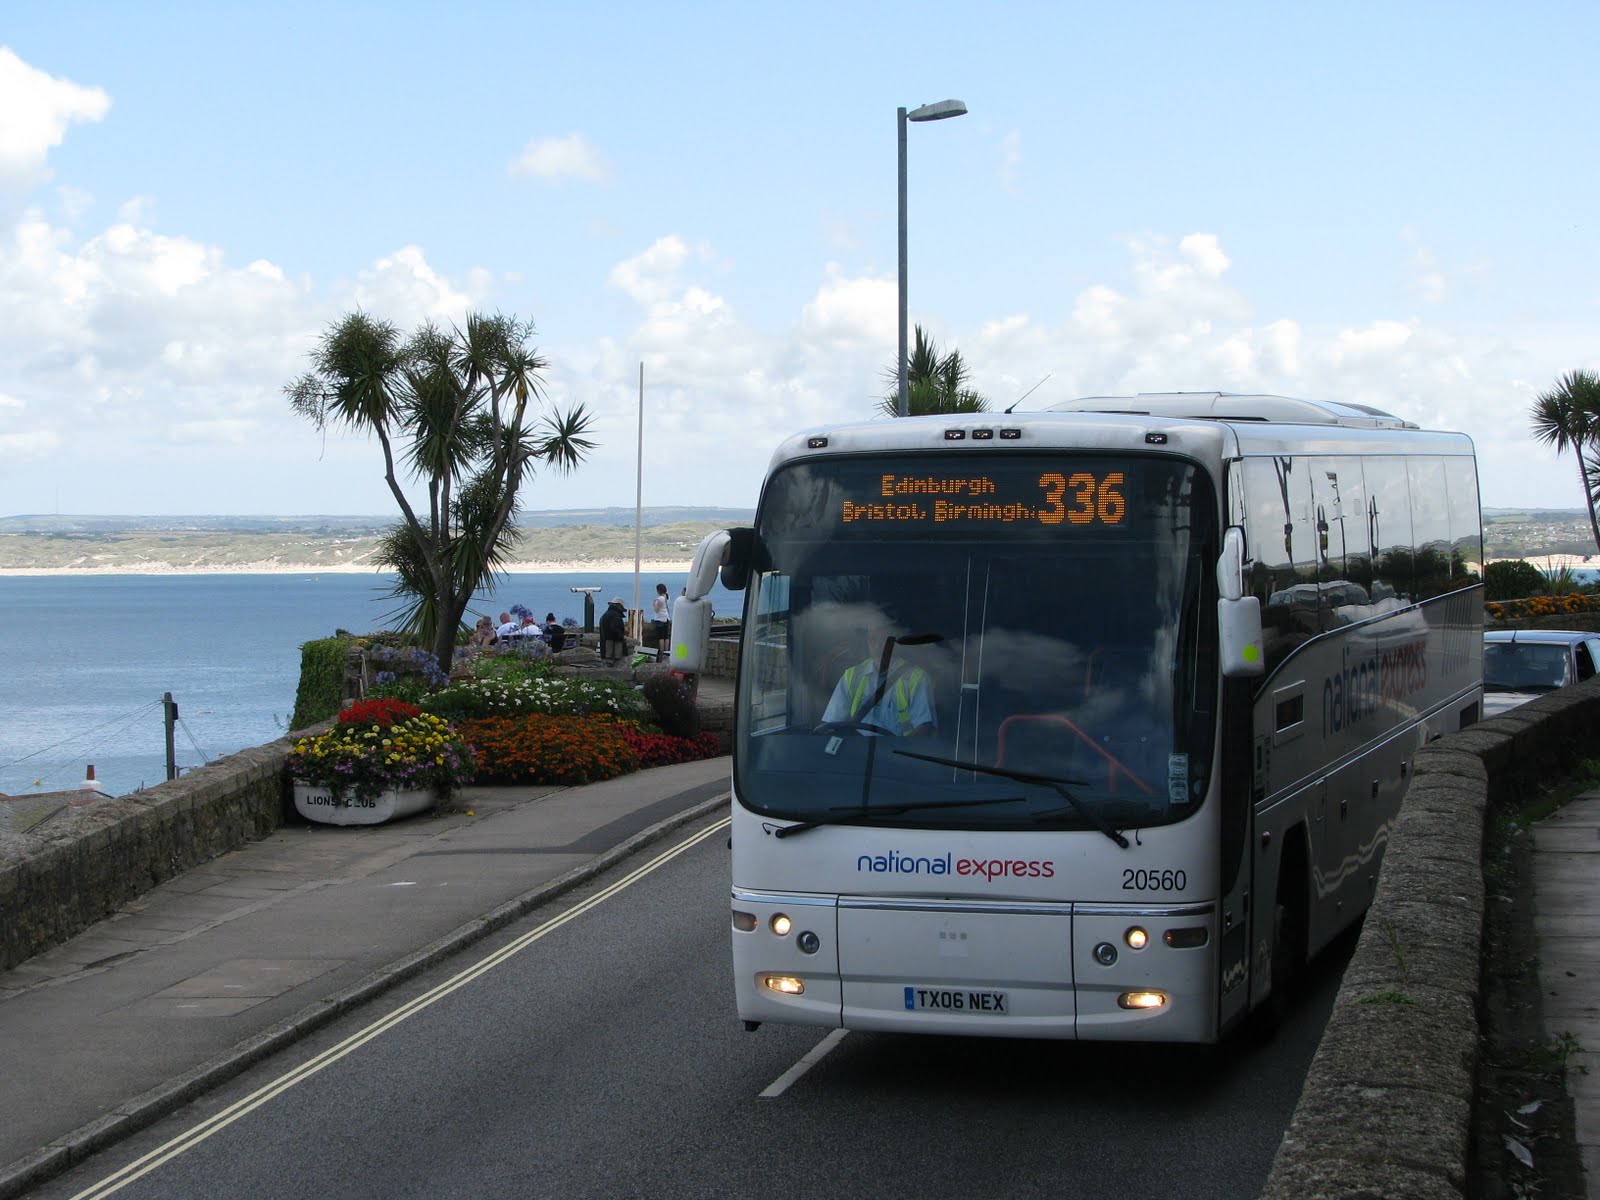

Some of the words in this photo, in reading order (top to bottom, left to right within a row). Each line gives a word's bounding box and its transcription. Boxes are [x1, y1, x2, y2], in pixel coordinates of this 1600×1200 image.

[881, 474, 996, 496] Edinburgh
[1038, 472, 1126, 525] 336
[1322, 637, 1379, 738] national
[306, 795, 338, 807] LIONS
[857, 850, 951, 875] national
[956, 857, 1055, 882] express
[1122, 869, 1187, 891] 20560
[917, 990, 964, 1009] TX06
[969, 992, 1004, 1011] NEX
